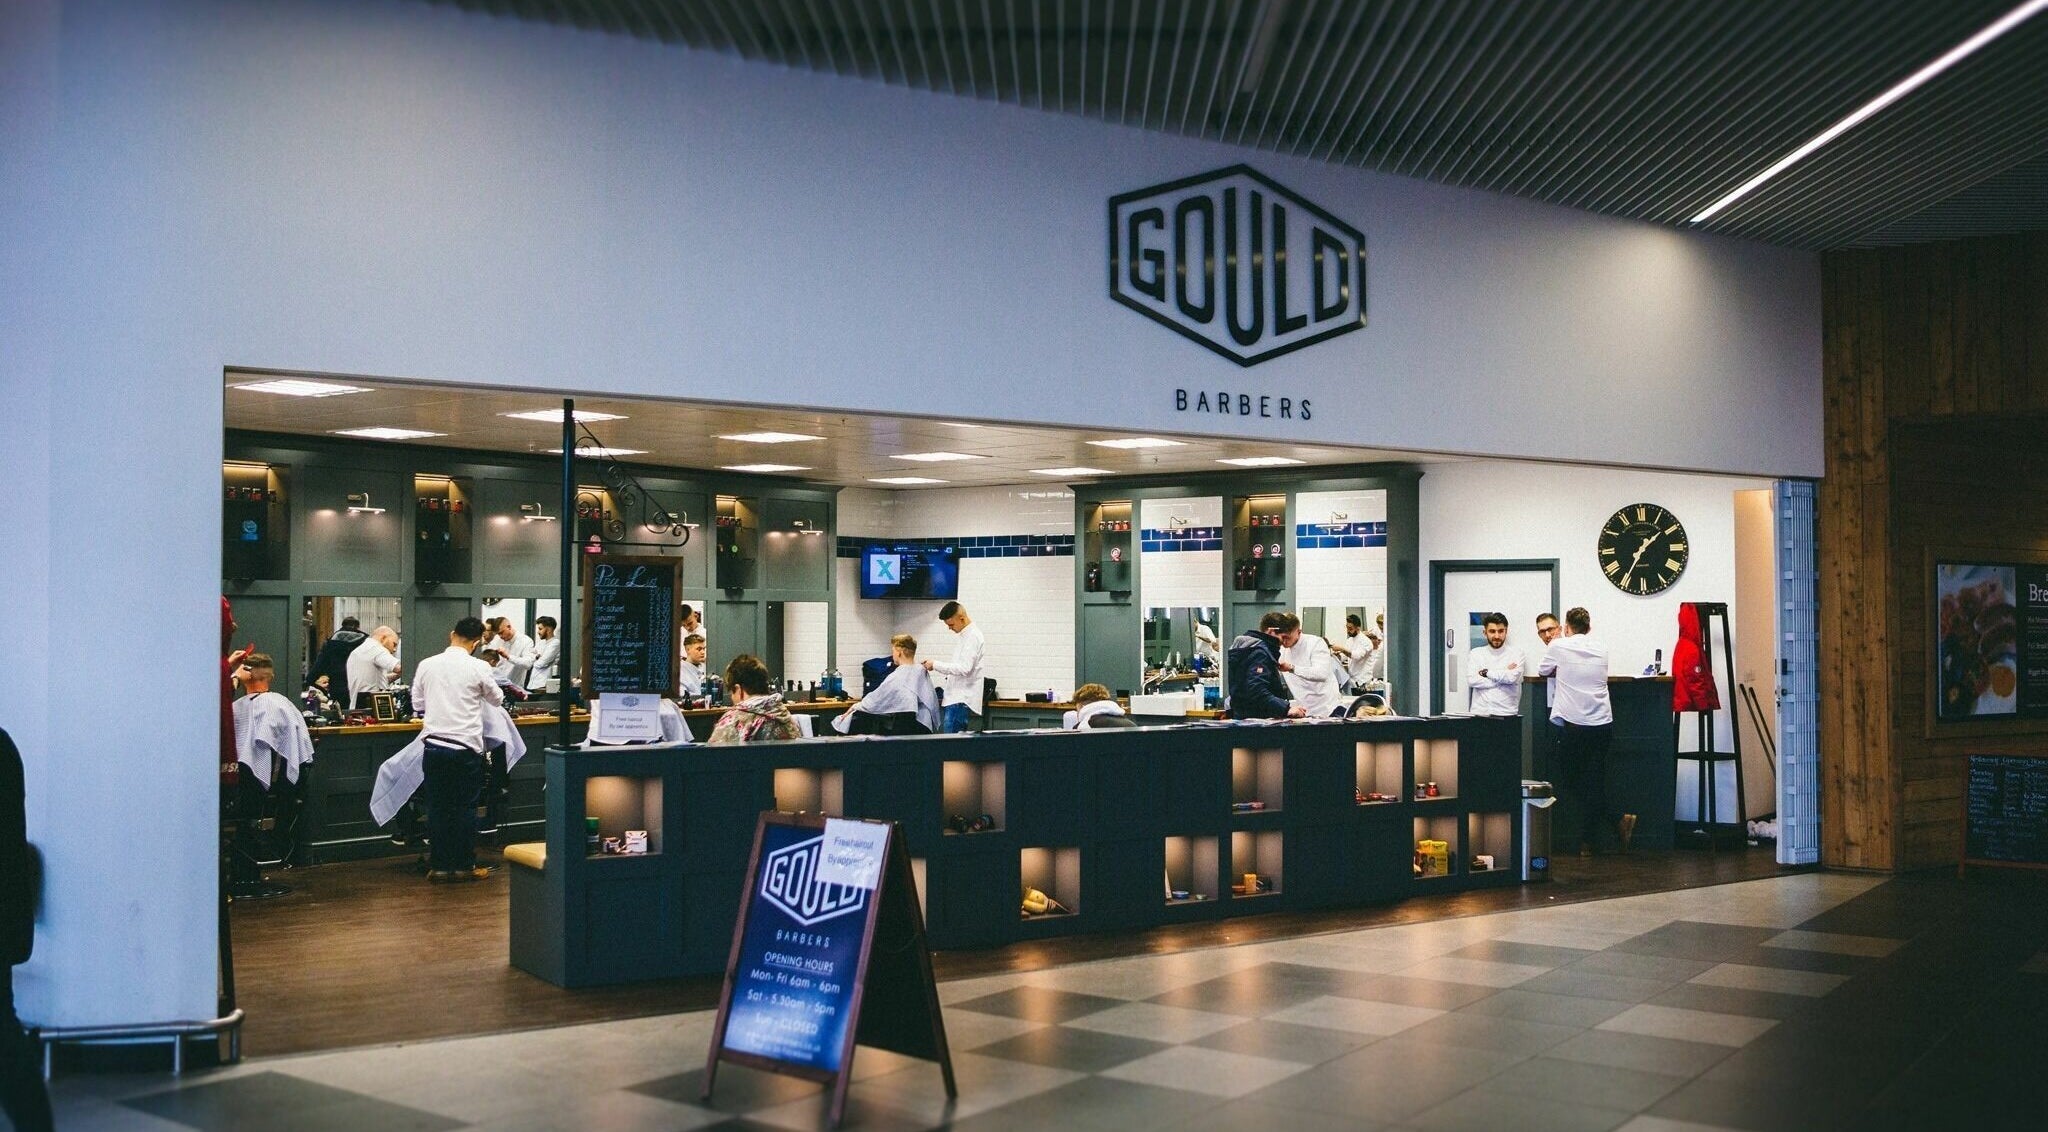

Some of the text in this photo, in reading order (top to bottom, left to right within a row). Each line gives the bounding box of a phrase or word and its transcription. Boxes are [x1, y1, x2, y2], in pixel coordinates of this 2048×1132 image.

[1129, 187, 1348, 346] GOULD
[1176, 389, 1311, 420] BARBERS
[777, 930, 830, 948] BARBERS
[765, 952, 834, 973] OPENING HOURS
[776, 972, 787, 983] Fri
[790, 976, 810, 988] 6am
[819, 980, 840, 994] 6pm
[747, 989, 762, 1000] Sat
[814, 1002, 835, 1015] 5pm
